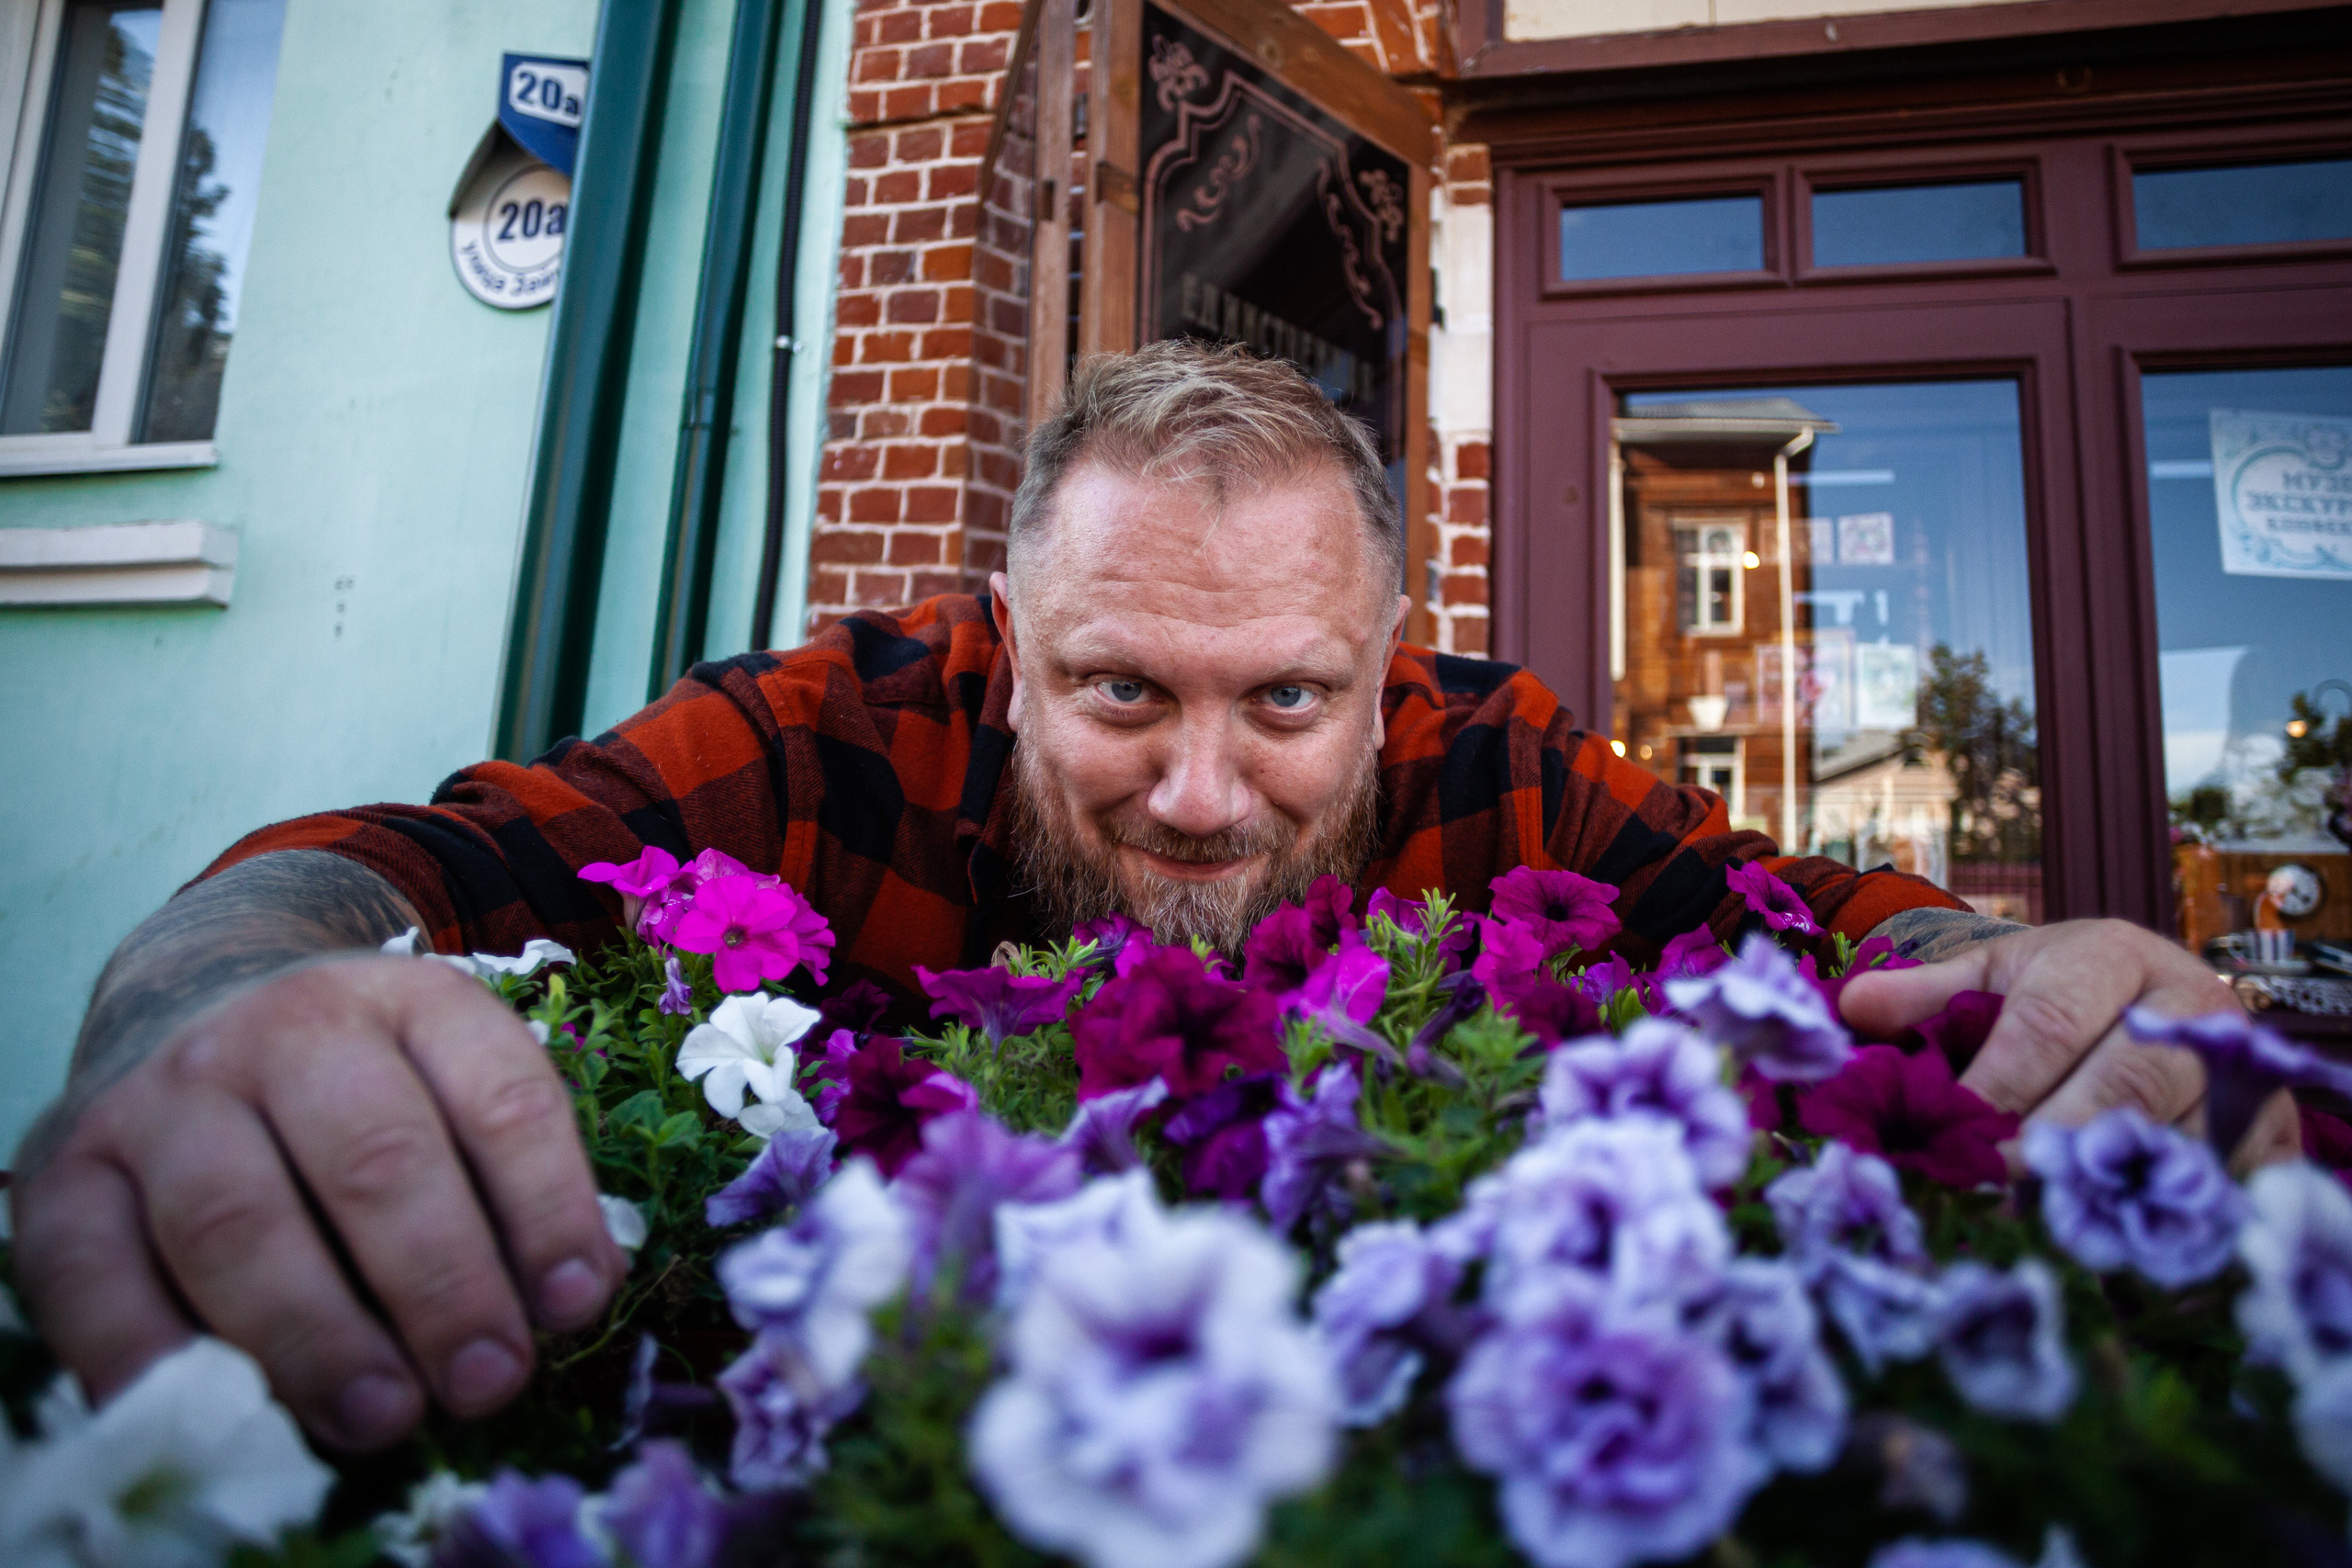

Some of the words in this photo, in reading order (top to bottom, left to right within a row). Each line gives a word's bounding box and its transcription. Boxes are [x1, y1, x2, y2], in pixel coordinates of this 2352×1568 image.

[516, 72, 579, 116] 20а
[498, 199, 567, 241] 20а
[461, 241, 505, 291] улица
